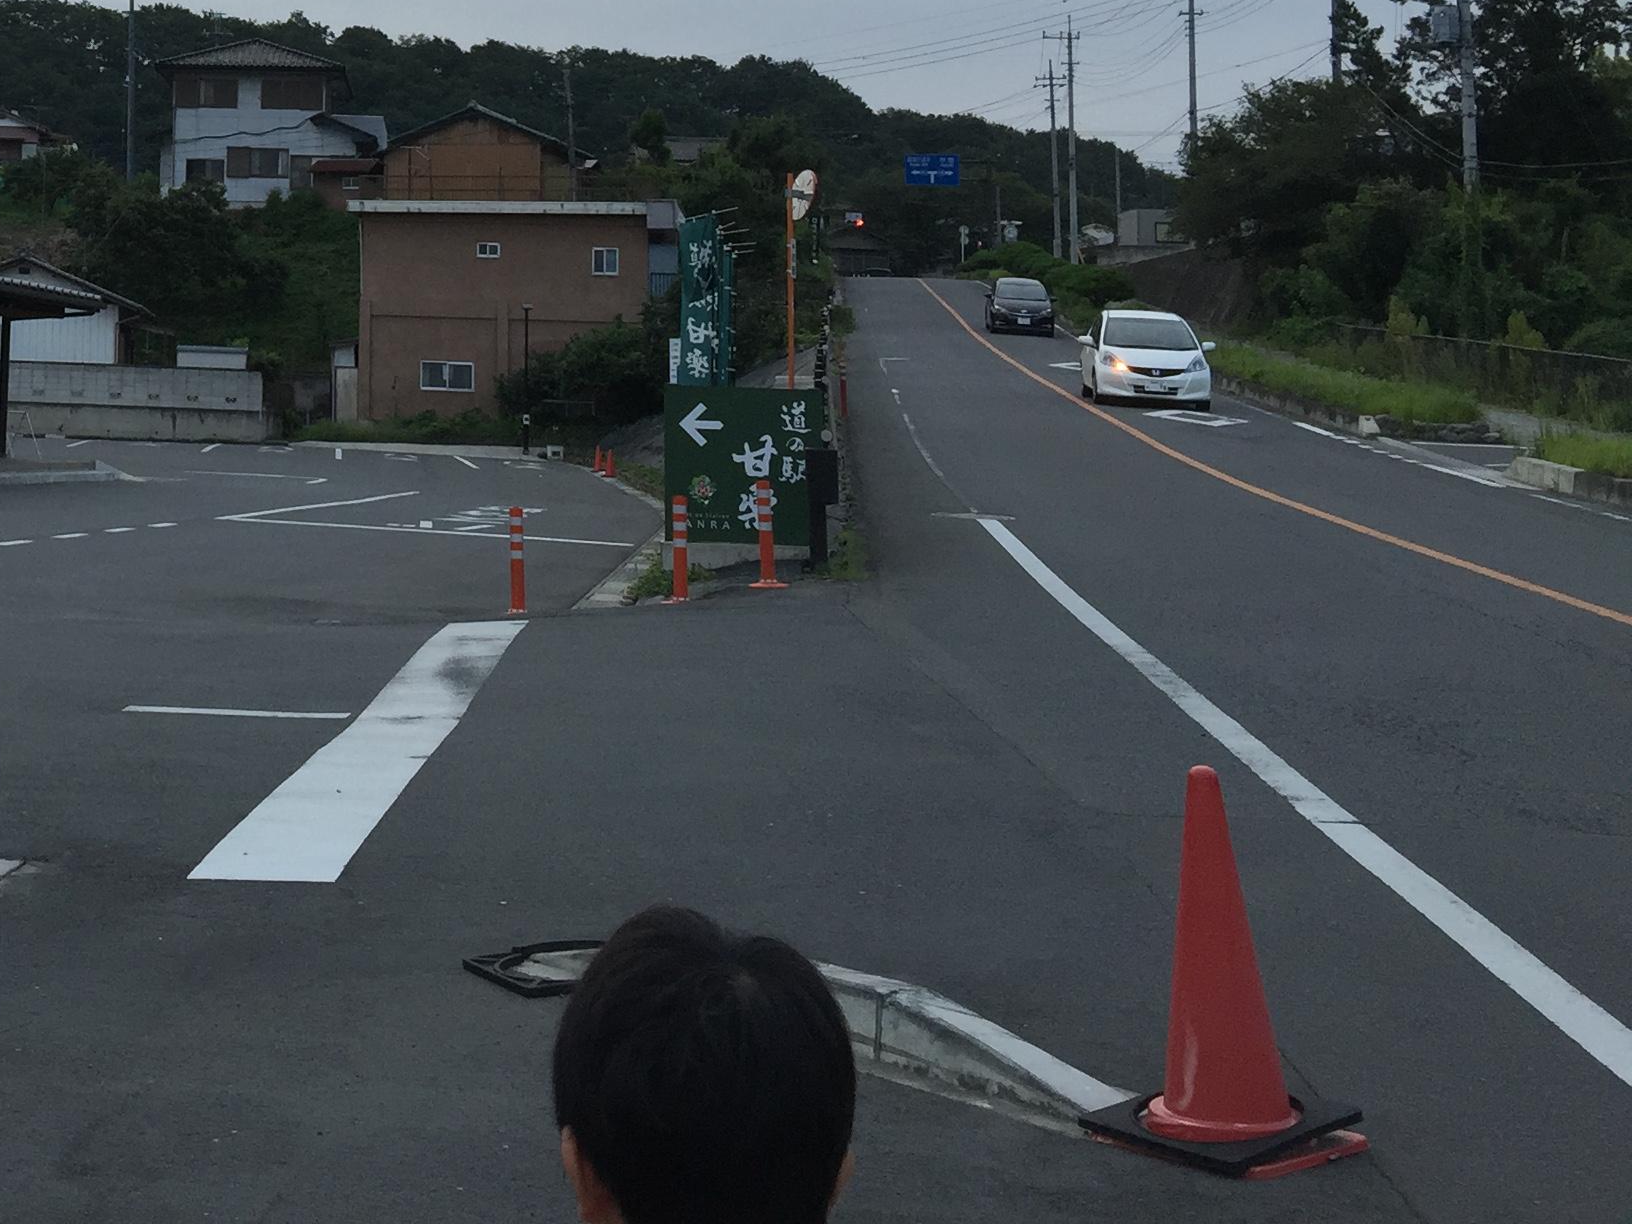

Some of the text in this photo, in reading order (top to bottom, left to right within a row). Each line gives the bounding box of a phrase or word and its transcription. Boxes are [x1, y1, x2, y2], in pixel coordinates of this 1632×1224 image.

[778, 400, 812, 484] 道の駅
[686, 519, 731, 530] ANRA
